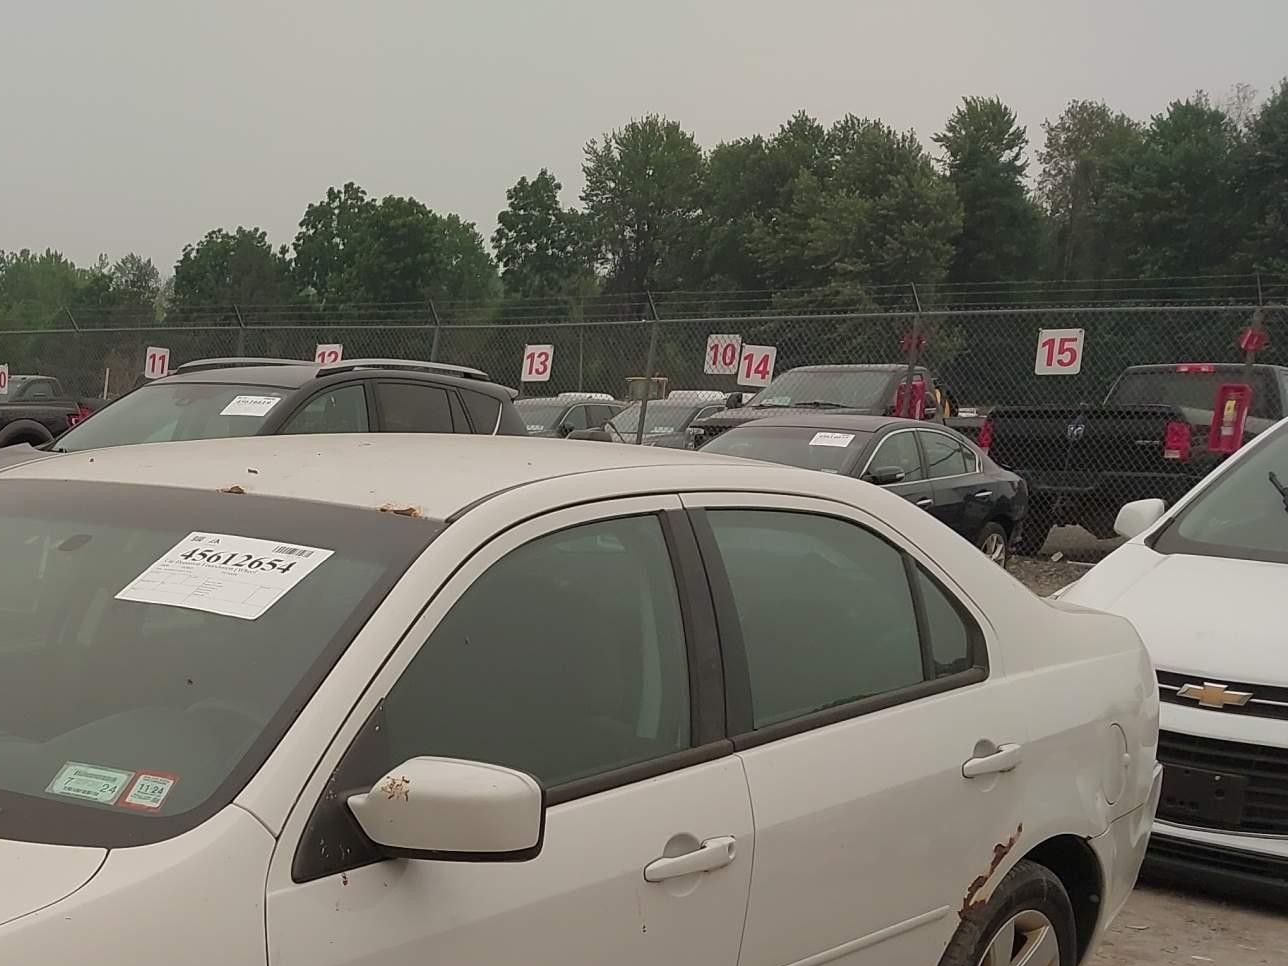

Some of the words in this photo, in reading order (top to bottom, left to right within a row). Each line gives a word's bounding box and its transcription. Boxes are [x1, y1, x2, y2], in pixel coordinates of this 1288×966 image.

[149, 353, 167, 375] 11
[317, 351, 340, 364] 12
[526, 351, 550, 376] 13
[709, 343, 737, 367] 10
[1041, 337, 1078, 367] 15
[743, 353, 770, 380] 14
[180, 547, 297, 575] 45612654
[99, 783, 118, 795] 24
[138, 782, 150, 793] 11
[151, 785, 164, 796] 24
